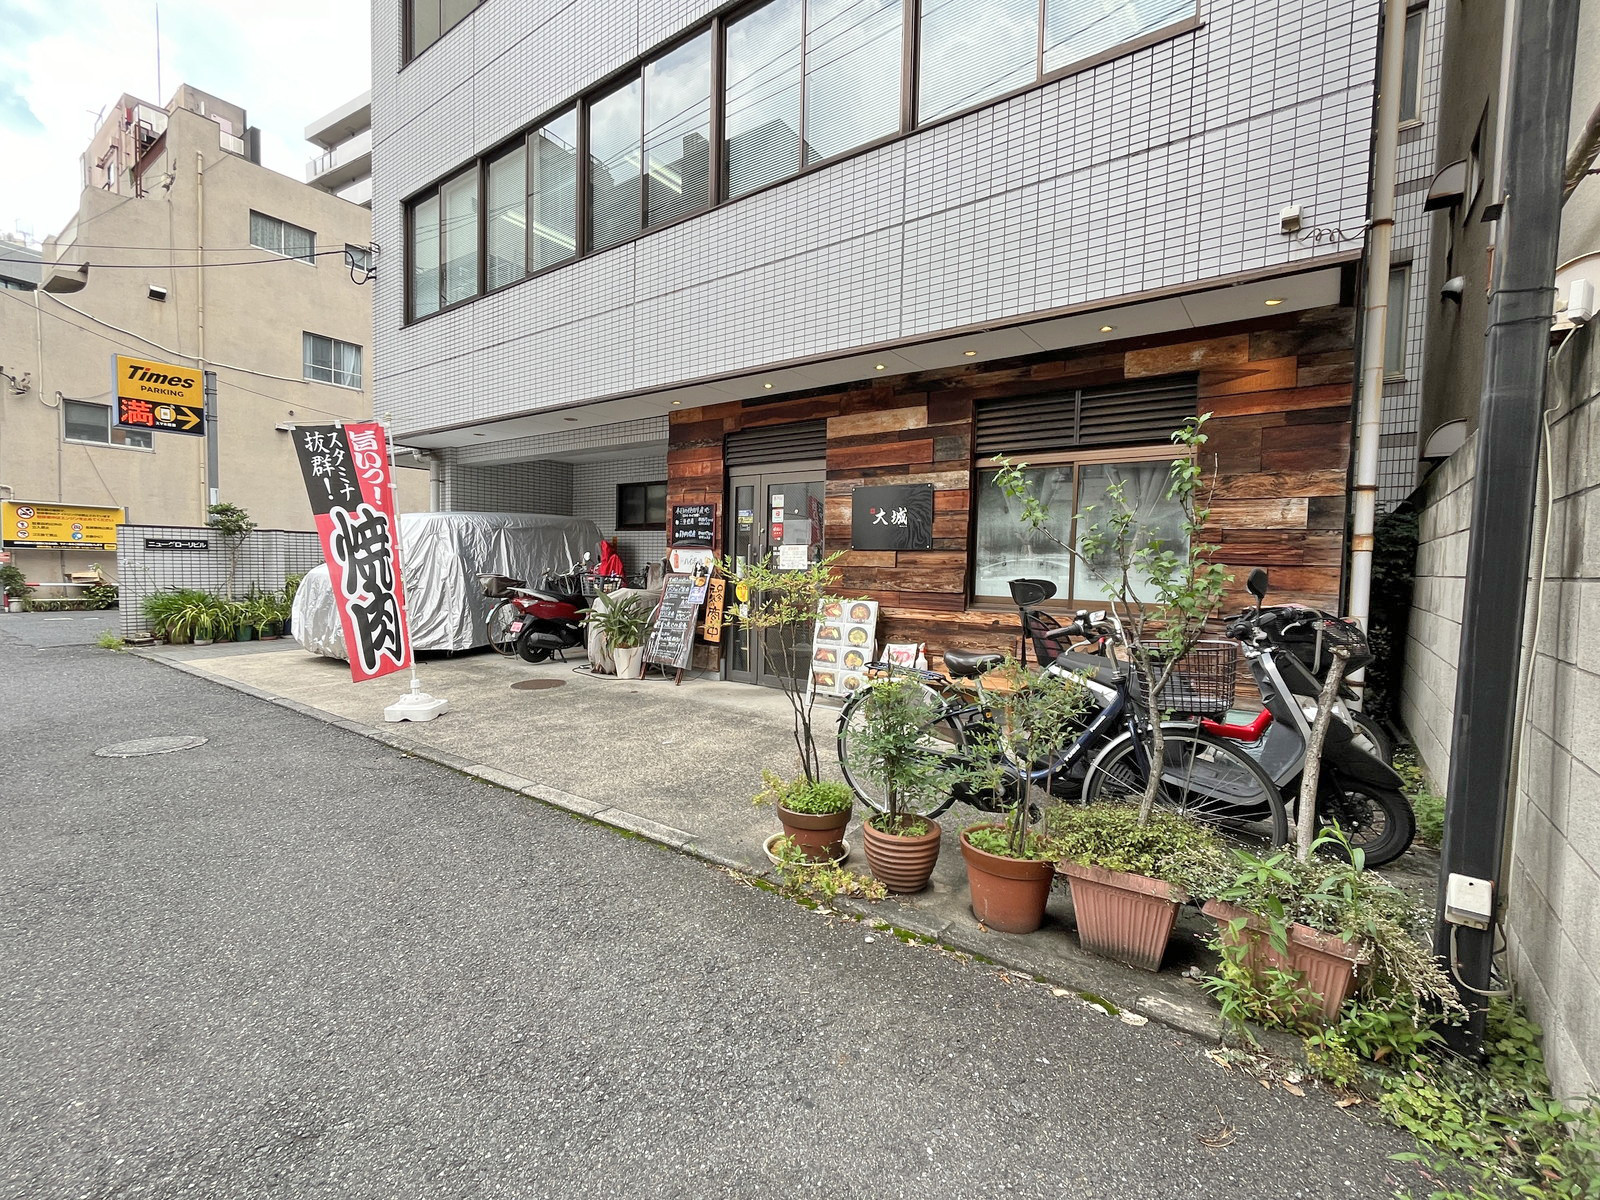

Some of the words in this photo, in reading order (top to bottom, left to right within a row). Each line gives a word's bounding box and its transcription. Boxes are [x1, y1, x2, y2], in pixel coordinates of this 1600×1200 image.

[128, 365, 195, 389] Times
[140, 385, 184, 398] PARKING
[121, 399, 154, 426] 満
[304, 431, 335, 500] 抜群！
[327, 432, 356, 501] スタミナ
[872, 506, 908, 525] 大城
[333, 505, 402, 672] 焼肉
